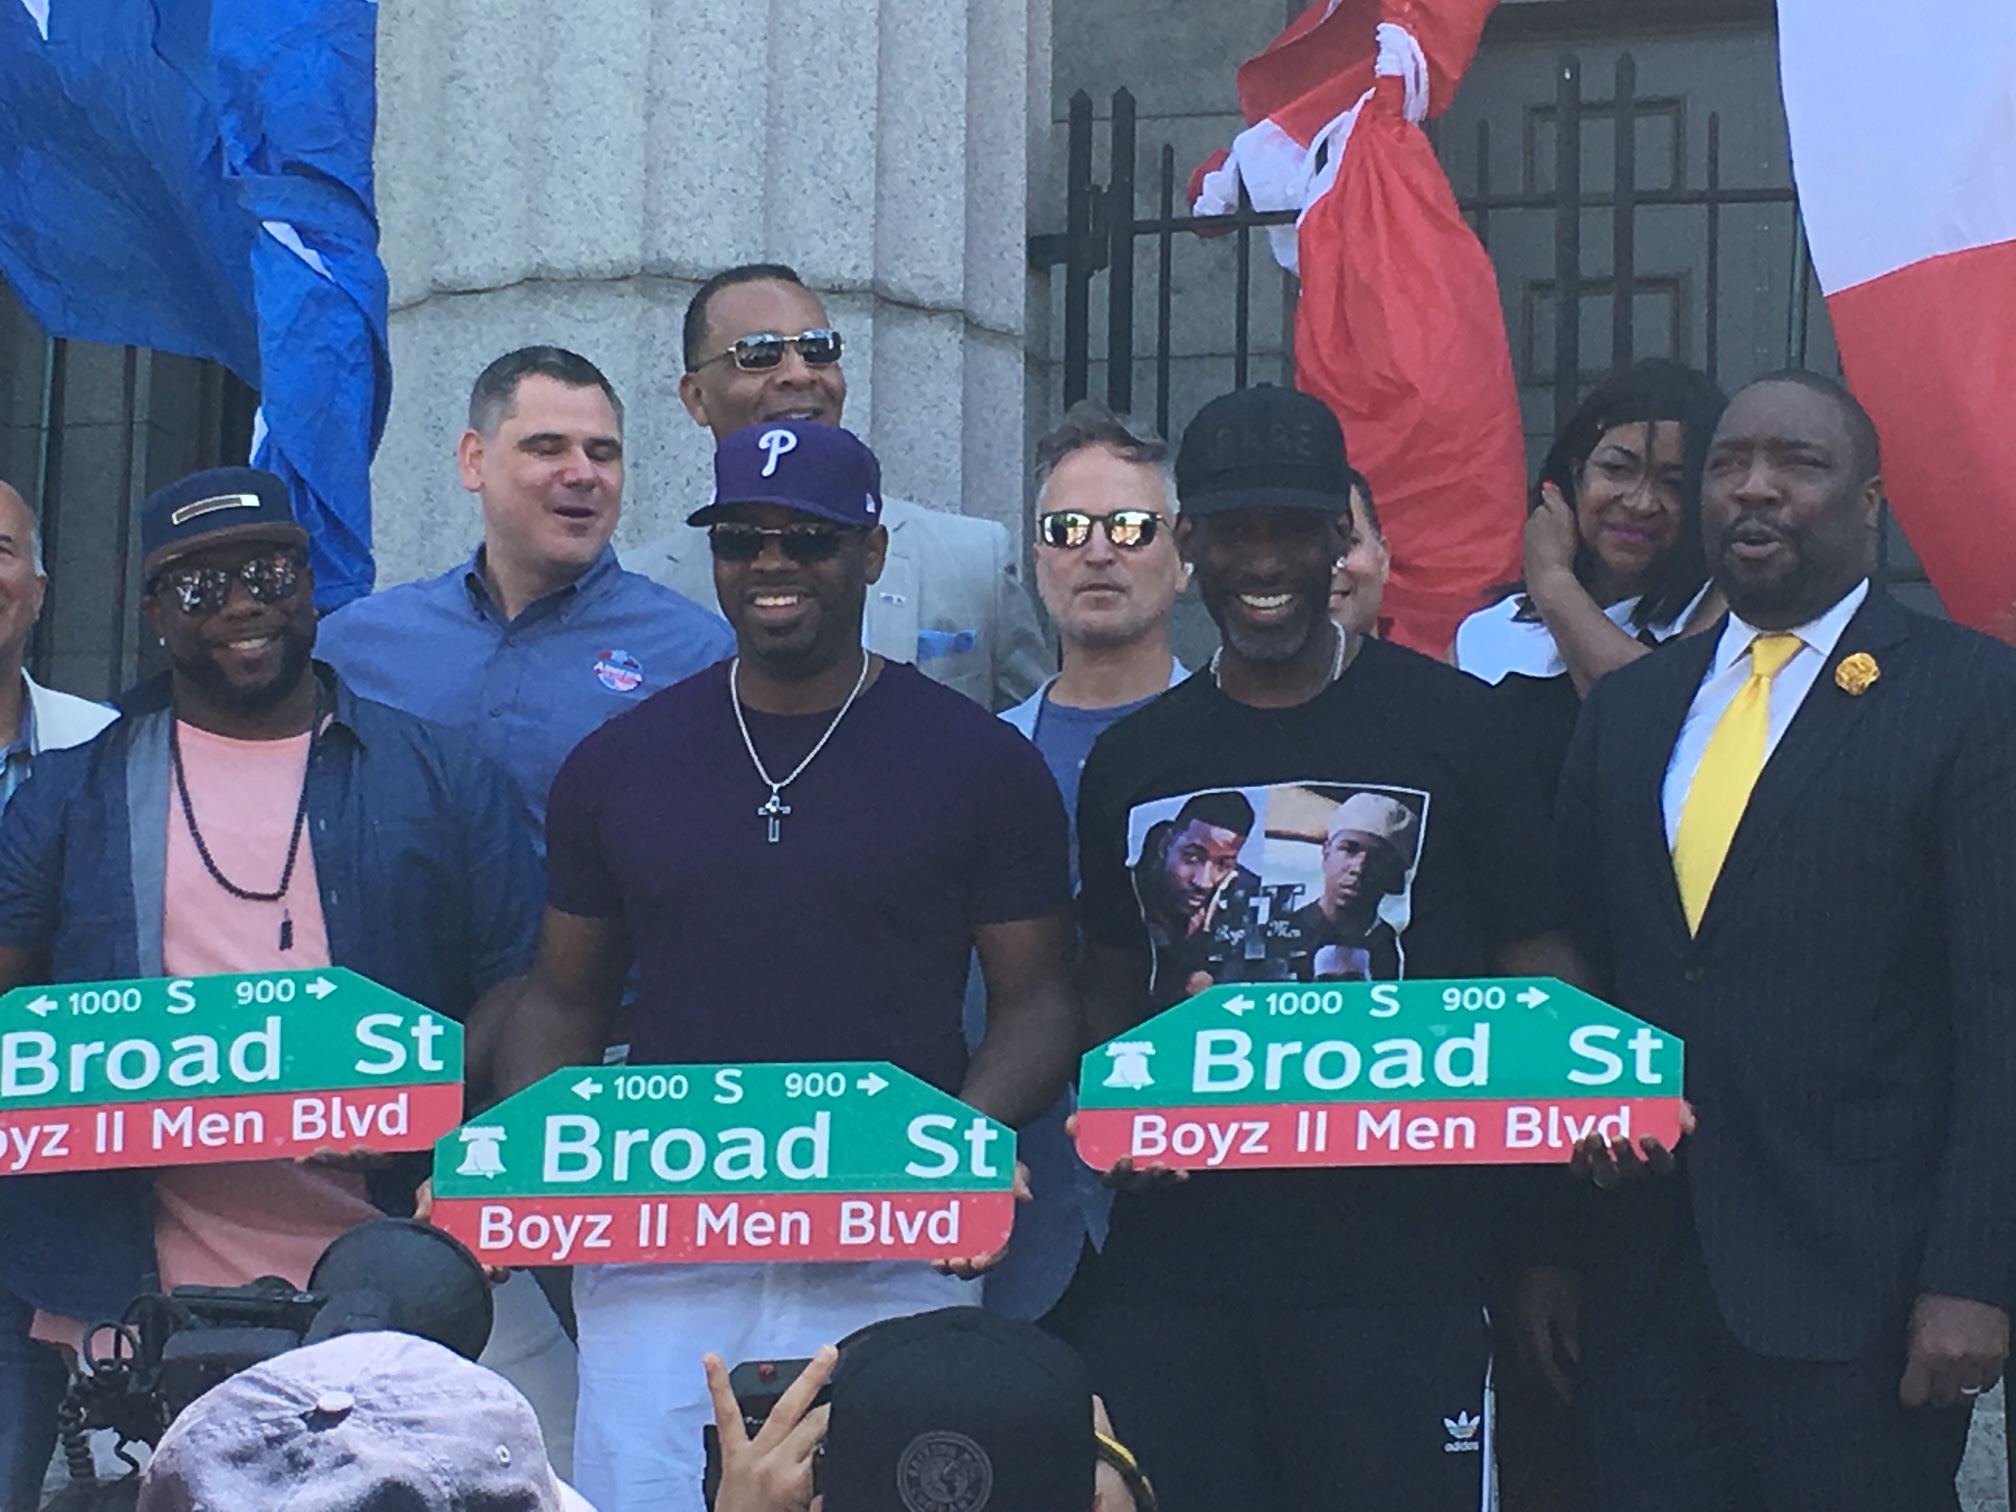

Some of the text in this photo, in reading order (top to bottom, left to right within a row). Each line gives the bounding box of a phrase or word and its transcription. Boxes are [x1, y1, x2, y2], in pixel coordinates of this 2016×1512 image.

[758, 429, 798, 477] P
[69, 979, 294, 1015] 1000 S 900
[1267, 985, 1505, 1017] 1000 S 900
[1, 1014, 443, 1097] Broad St
[1193, 1023, 1662, 1092] Broad St
[614, 1069, 845, 1104] 1000 S 900
[0, 1123, 69, 1171] yz
[152, 1105, 263, 1150] Men
[292, 1092, 408, 1141] Blvd
[543, 1111, 997, 1182] Broad St
[1131, 1114, 1270, 1166] Boyz
[1356, 1108, 1476, 1151] Men
[1505, 1105, 1630, 1148] Blvd
[479, 1205, 613, 1261] Boyz
[696, 1202, 810, 1247] Men
[839, 1200, 960, 1245] Blvd
